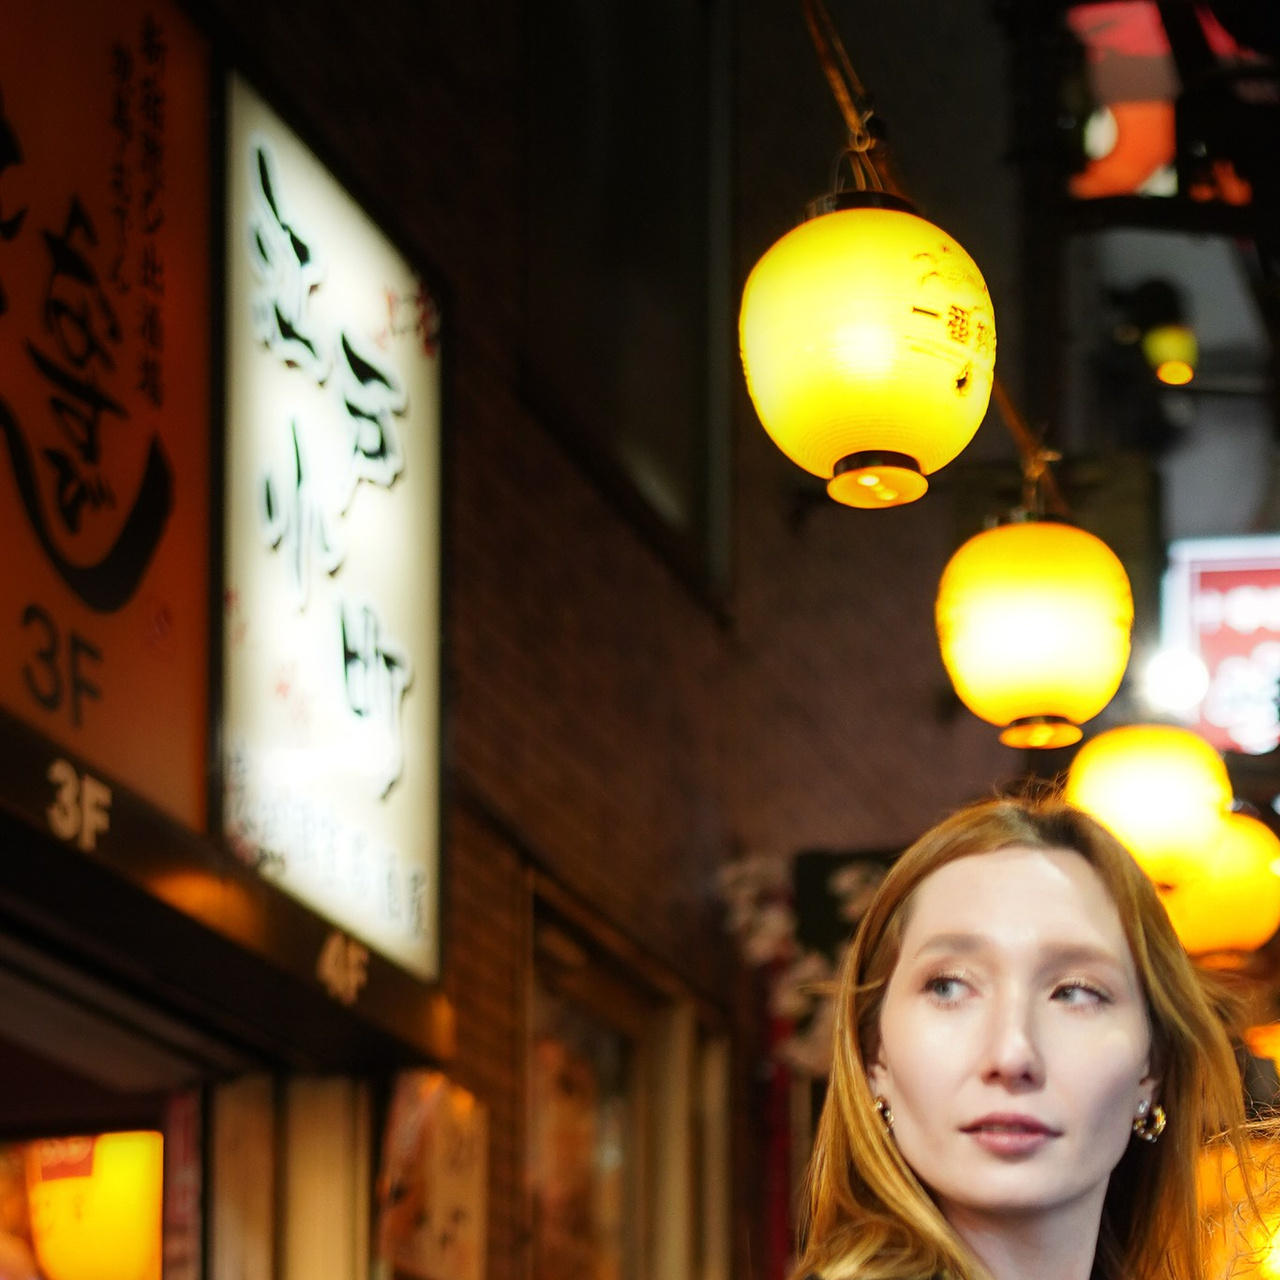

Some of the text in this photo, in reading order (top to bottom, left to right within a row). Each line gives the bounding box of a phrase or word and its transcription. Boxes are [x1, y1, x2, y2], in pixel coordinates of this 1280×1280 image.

[22, 604, 103, 728] 3F
[47, 758, 112, 853] 3F
[316, 931, 370, 1005] 4F
